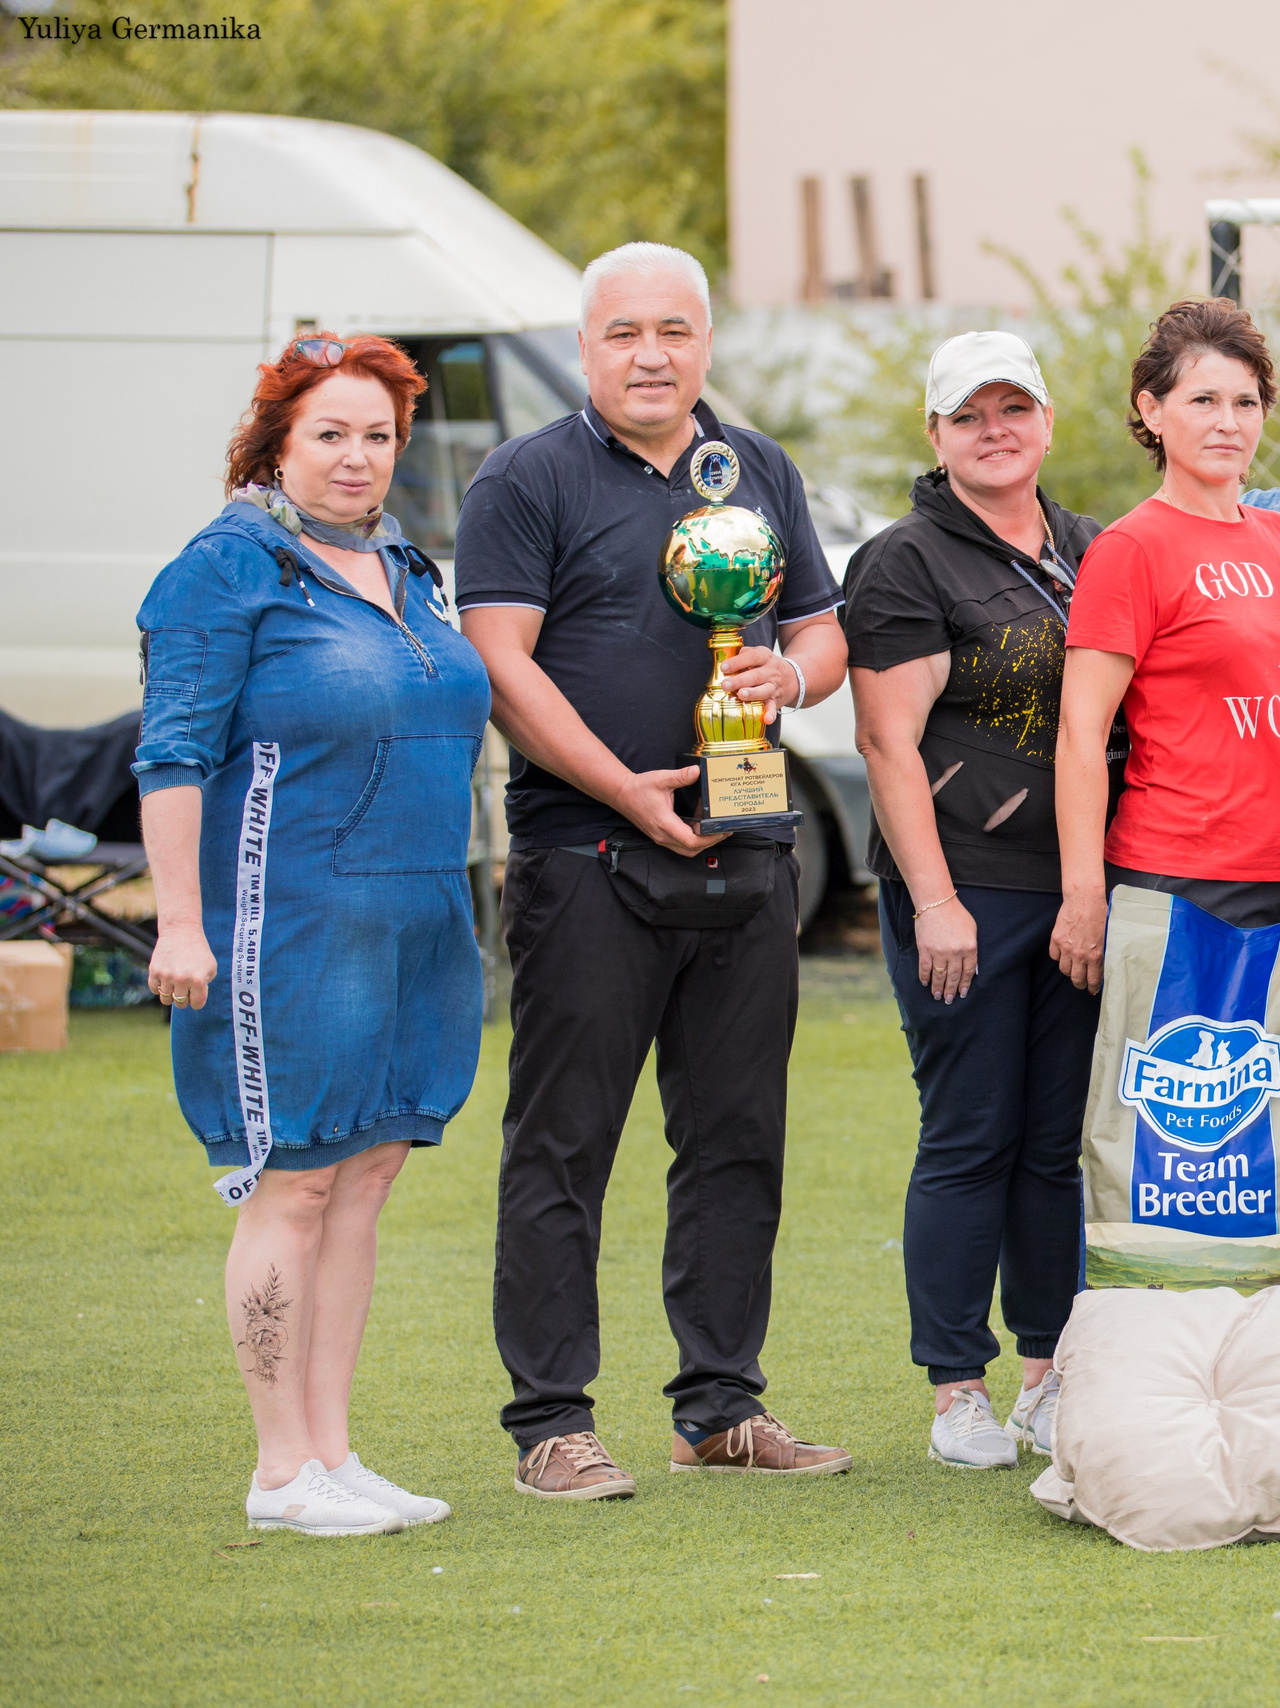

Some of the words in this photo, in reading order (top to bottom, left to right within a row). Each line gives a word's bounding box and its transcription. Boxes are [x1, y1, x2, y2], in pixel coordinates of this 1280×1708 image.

[1196, 561, 1273, 601] GOD
[719, 792, 779, 802] ПРЕДСТАВИТЕЛЬ
[734, 786, 763, 794] ЛУЧШИЙ
[240, 889, 249, 916] Weight
[237, 917, 248, 952] Securing
[236, 955, 245, 983] System
[239, 991, 265, 1124] OFF-WHITE
[1134, 1057, 1272, 1102] Farmina
[1166, 1112, 1194, 1128] Pet
[1200, 1104, 1242, 1128] Foods
[1158, 1152, 1249, 1182] Team
[1139, 1181, 1271, 1217] Breeder
